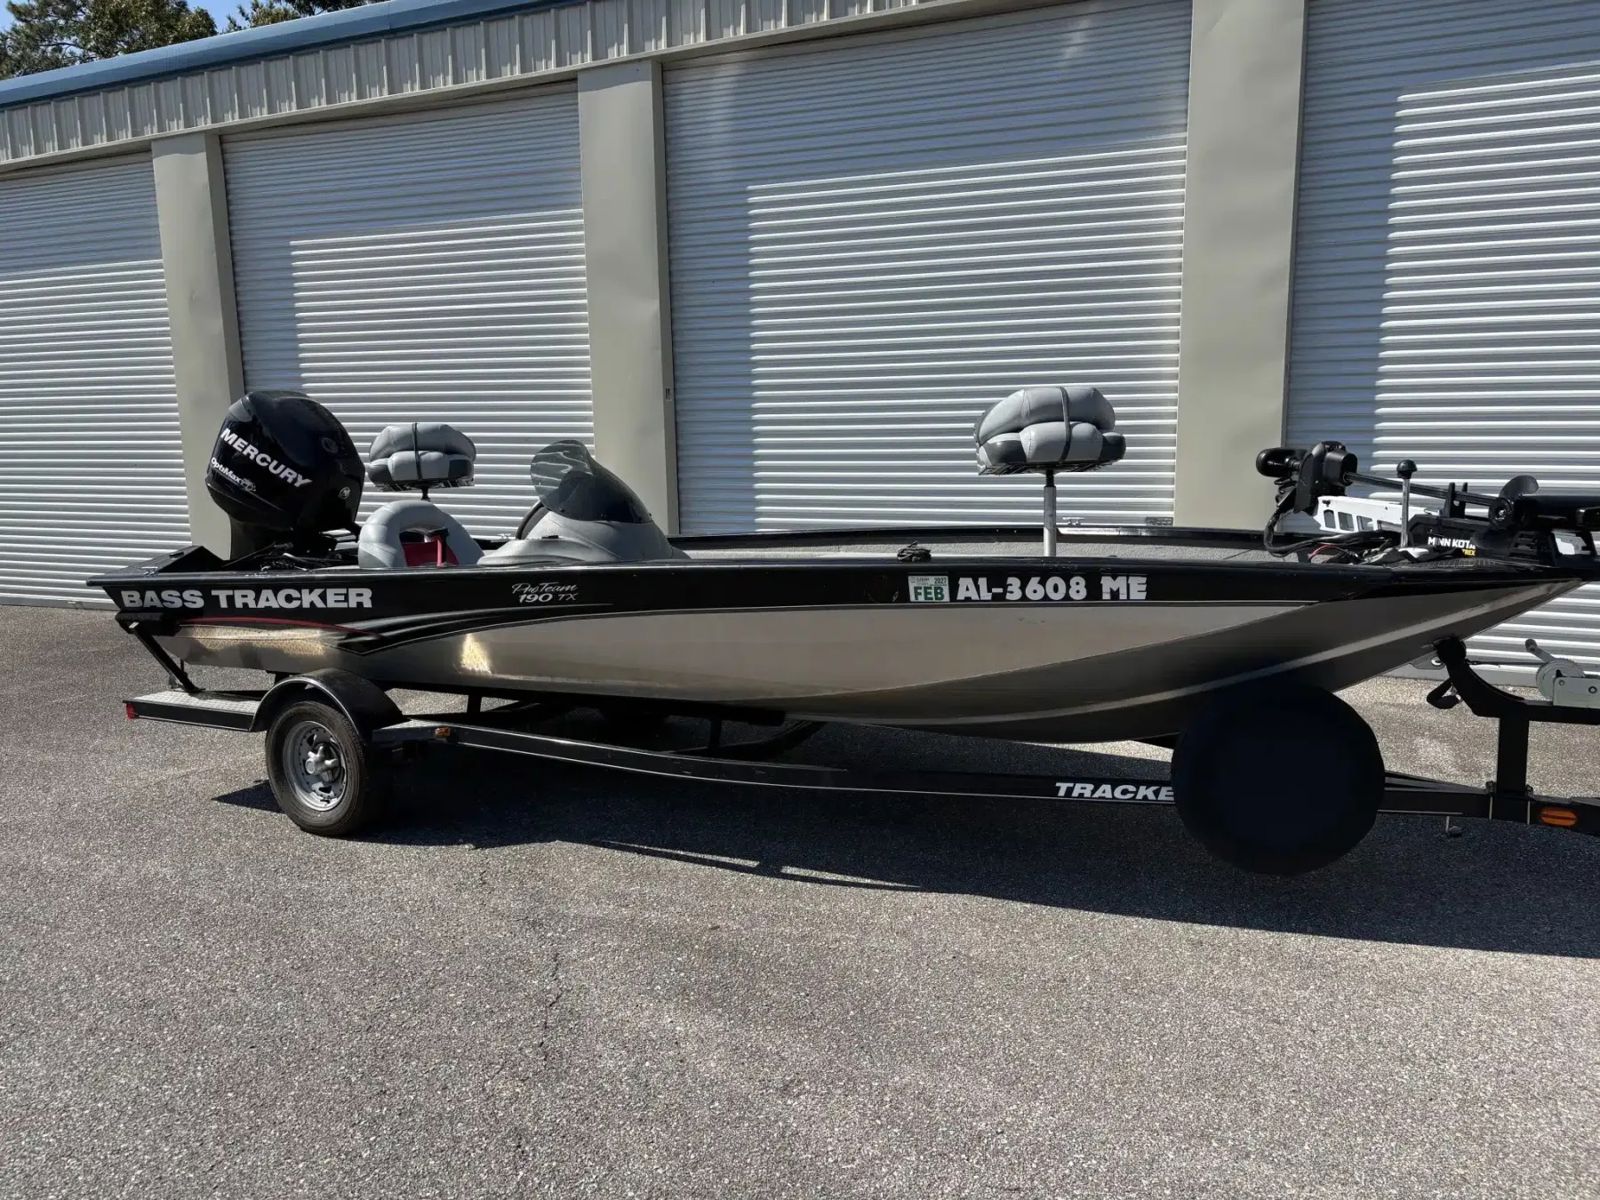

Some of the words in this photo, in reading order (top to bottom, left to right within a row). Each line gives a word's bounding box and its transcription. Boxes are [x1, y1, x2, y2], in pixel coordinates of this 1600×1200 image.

[220, 428, 312, 488] MERCURY
[210, 457, 241, 483] OptiMax
[121, 590, 204, 609] BASS
[211, 588, 373, 608] TRACKER
[519, 593, 553, 603] 190
[557, 593, 578, 601] TX
[913, 586, 945, 601] FEB
[956, 576, 1087, 601] AL-3608
[1100, 576, 1147, 601] ME
[1055, 782, 1175, 801] TRACKE
